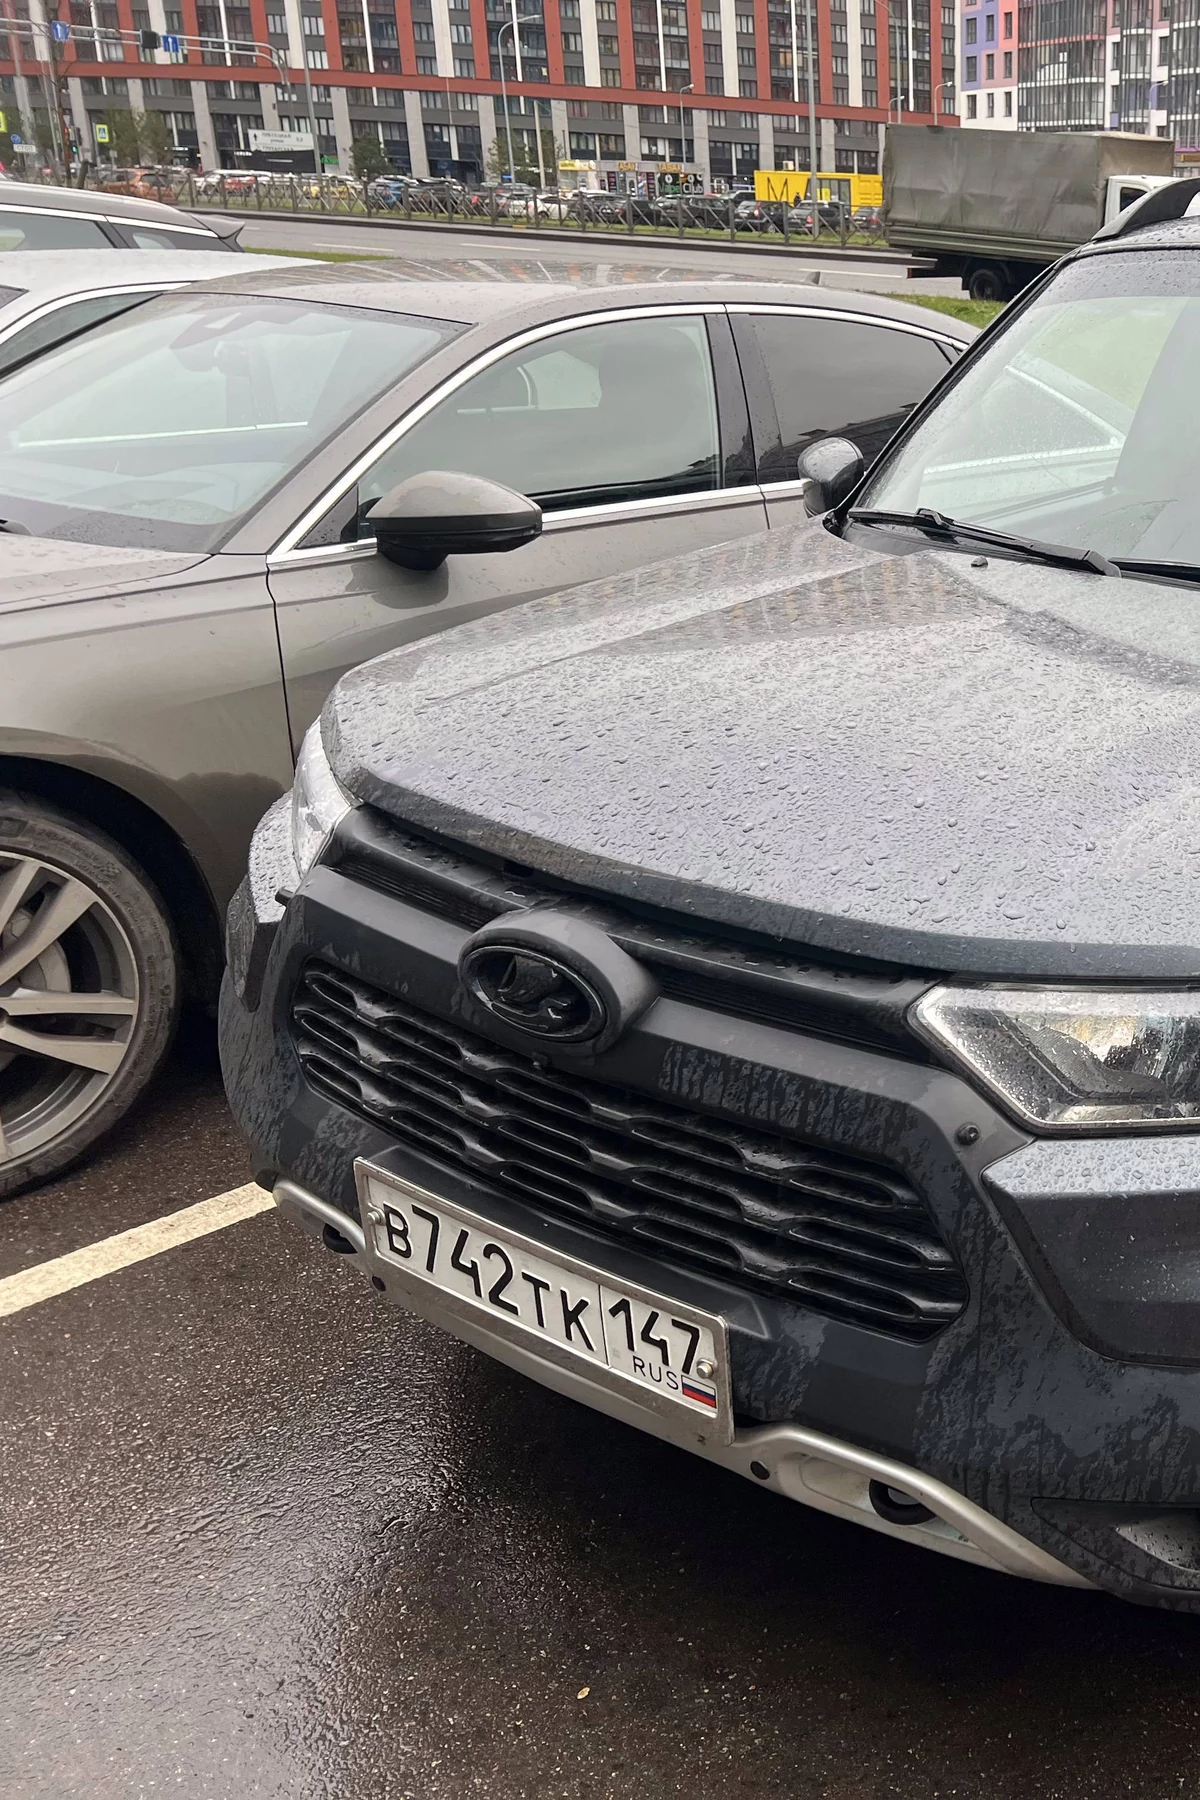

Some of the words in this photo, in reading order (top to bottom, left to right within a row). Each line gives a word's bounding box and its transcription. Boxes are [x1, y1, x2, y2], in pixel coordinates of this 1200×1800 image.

[682, 183, 703, 194] Club
[608, 1297, 701, 1376] 147
[631, 1353, 680, 1392] RUS
